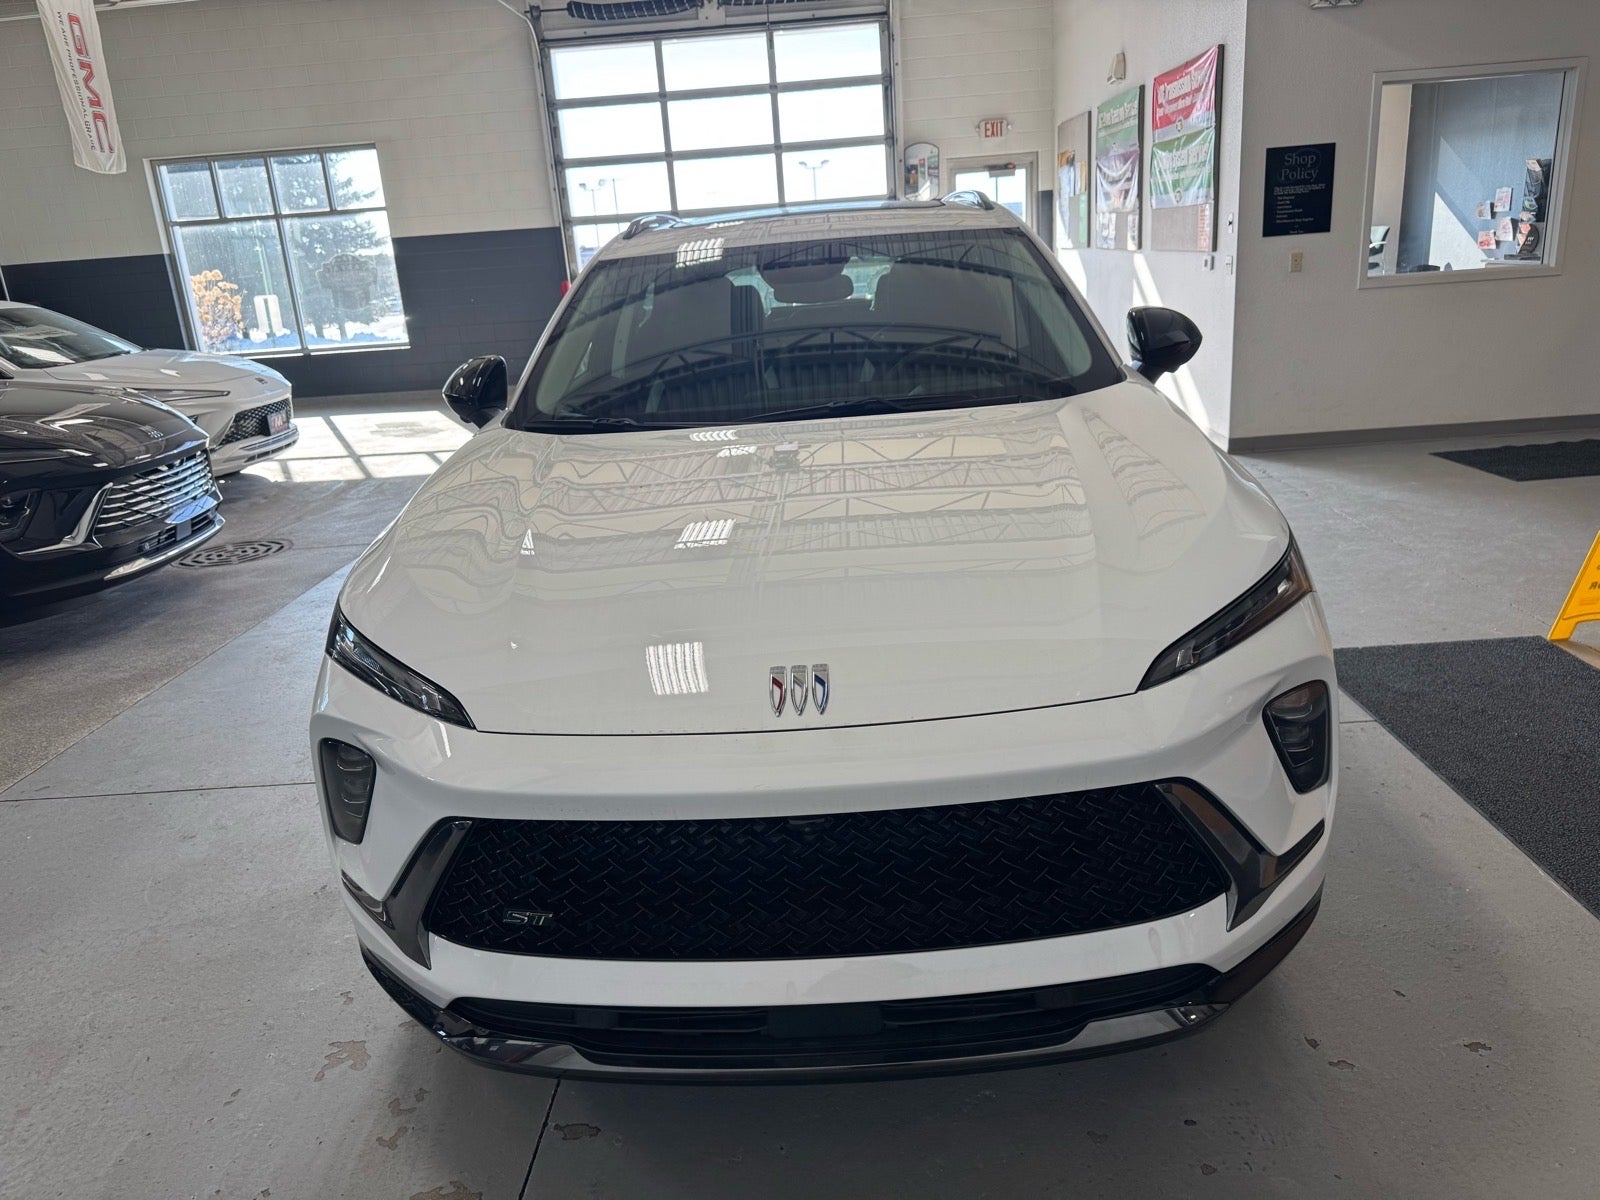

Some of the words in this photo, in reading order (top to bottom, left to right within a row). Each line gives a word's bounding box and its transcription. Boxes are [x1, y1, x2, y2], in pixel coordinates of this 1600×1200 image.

[67, 12, 115, 153] GMC
[984, 120, 1004, 138] EXIT
[1284, 152, 1317, 168] Shop
[1281, 167, 1319, 182] Policy
[503, 910, 553, 926] ST
